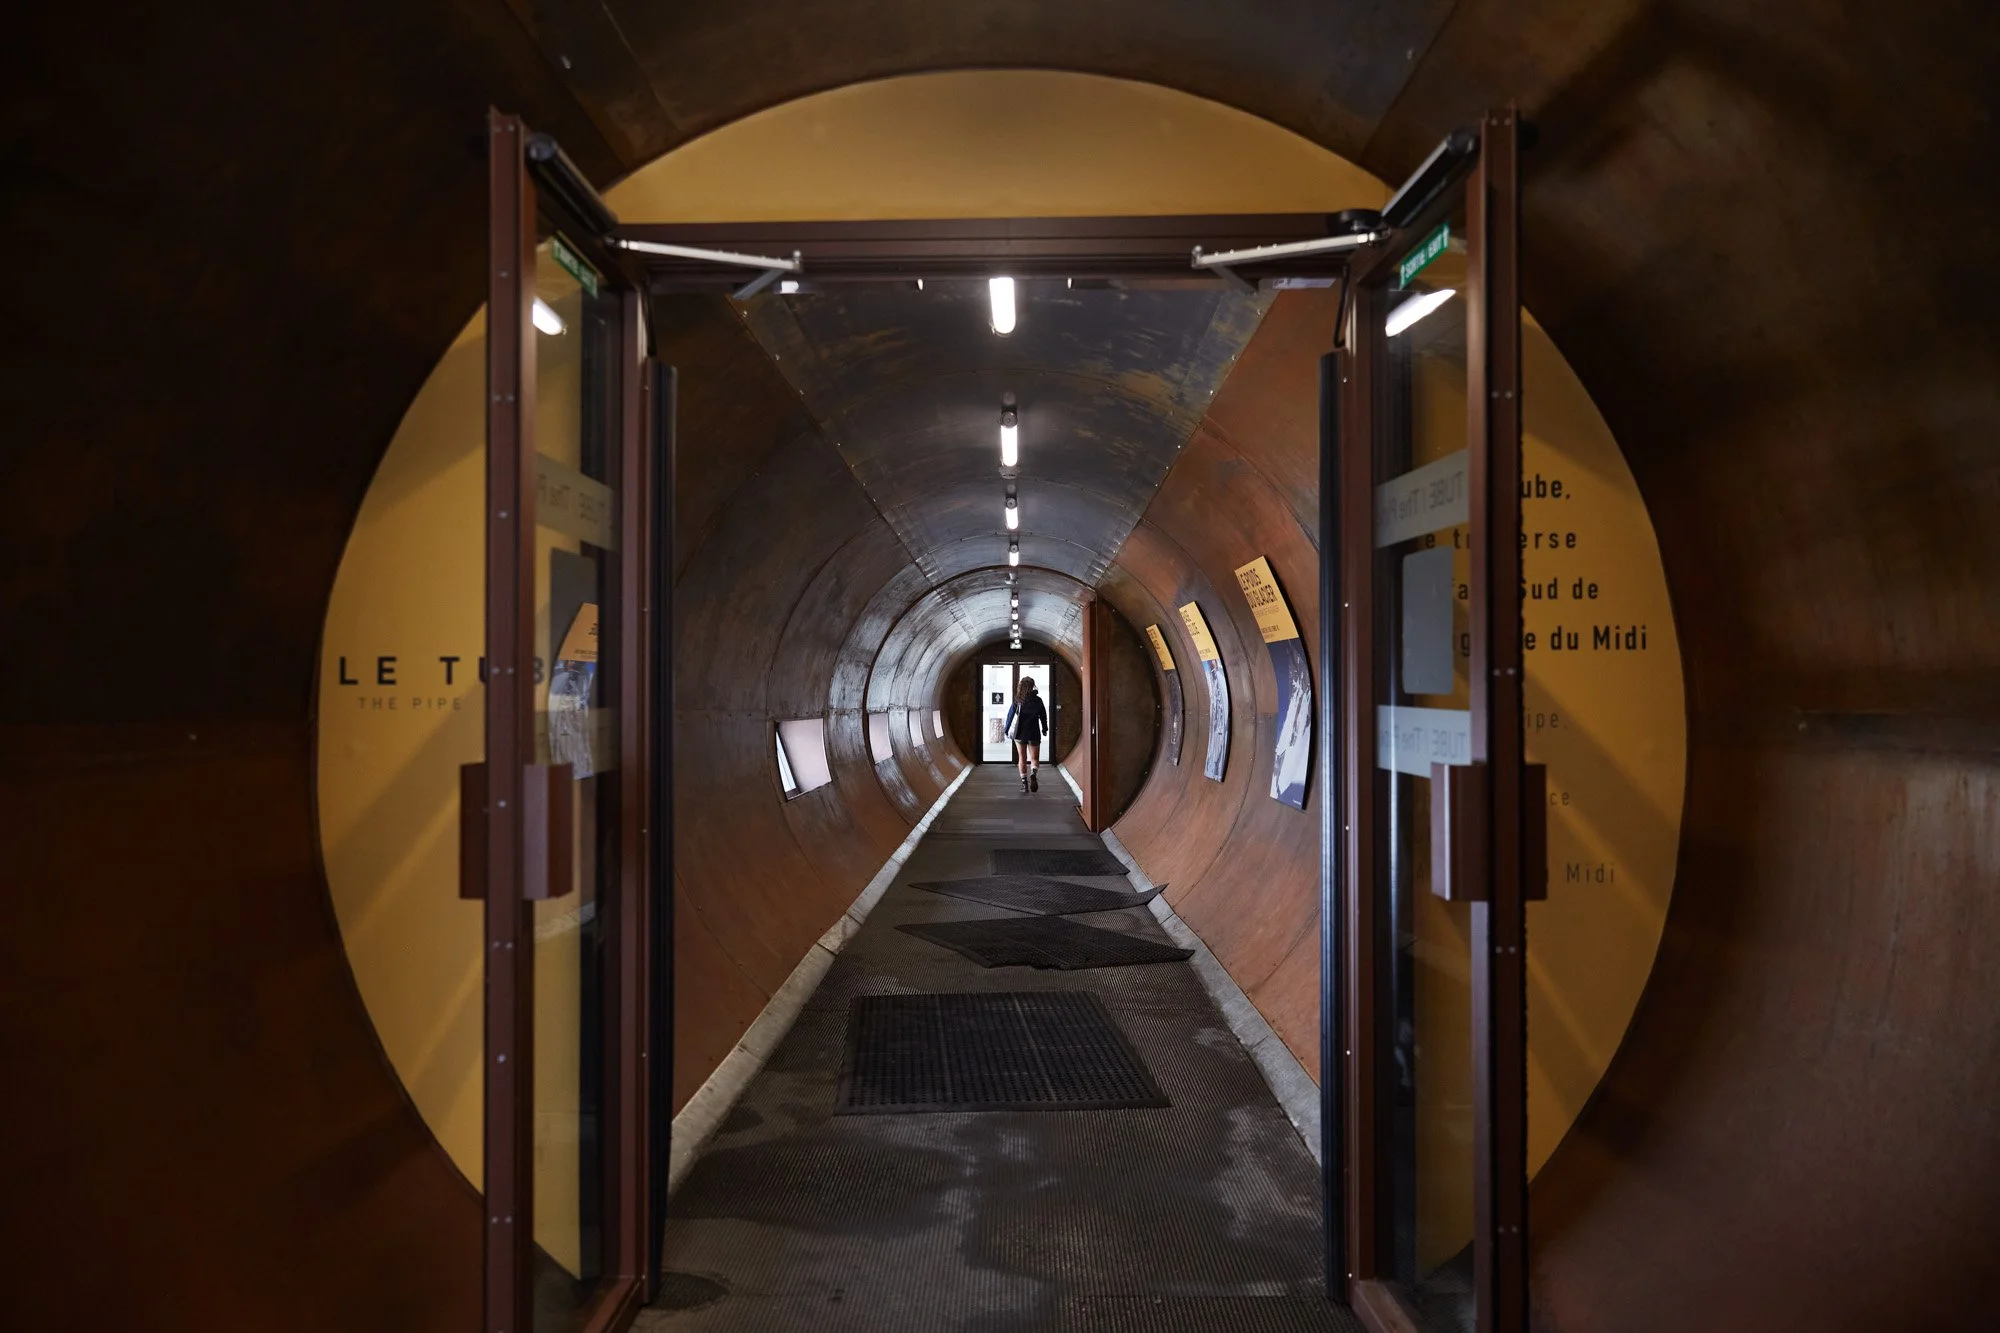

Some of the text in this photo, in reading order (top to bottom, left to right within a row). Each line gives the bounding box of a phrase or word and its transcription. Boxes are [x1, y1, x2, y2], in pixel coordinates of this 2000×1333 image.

[1519, 474, 1571, 500] ube,
[1572, 577, 1599, 600] de
[1551, 625, 1579, 650] du
[1593, 625, 1647, 650] Midi
[339, 656, 397, 686] LE
[358, 697, 463, 710] THE PIPE
[1566, 862, 1616, 884] Midi
